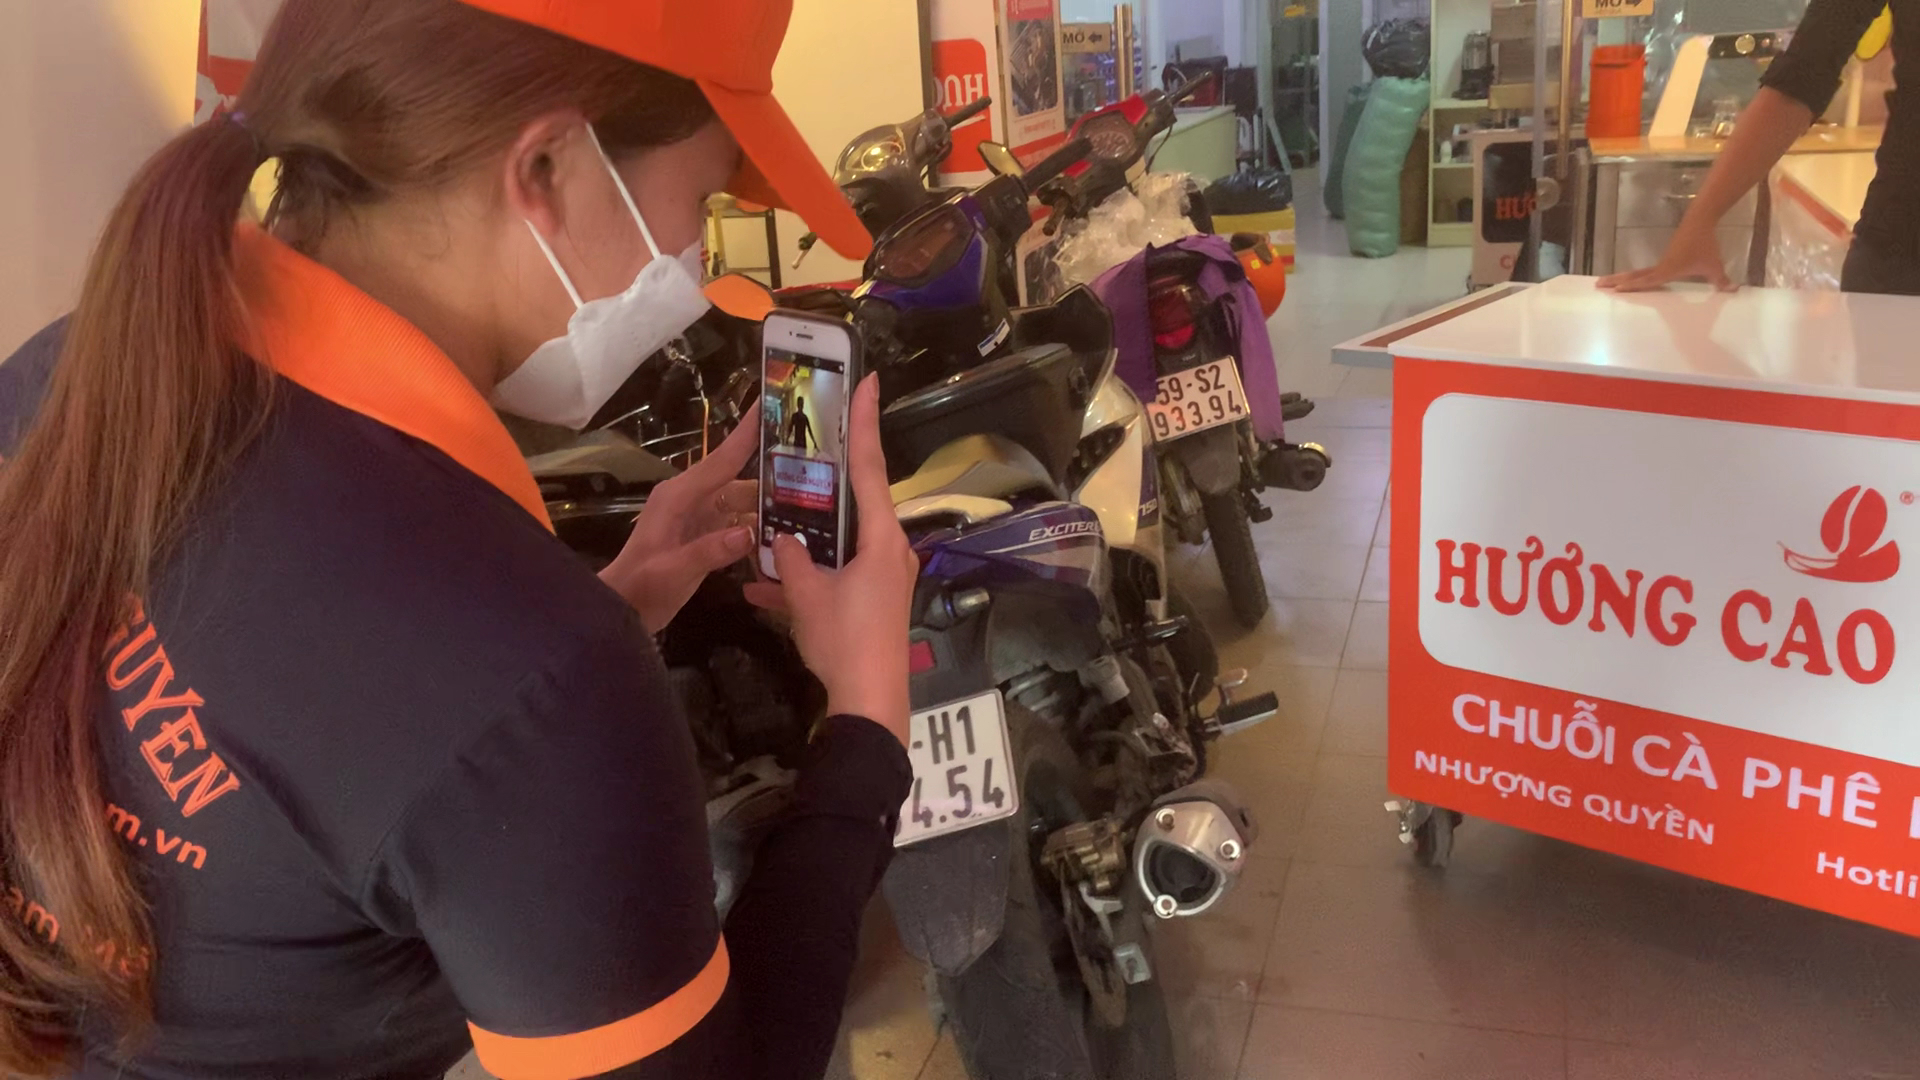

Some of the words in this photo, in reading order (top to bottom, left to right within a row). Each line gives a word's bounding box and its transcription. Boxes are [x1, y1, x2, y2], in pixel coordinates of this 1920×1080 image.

[1154, 389, 1242, 437] 933.94
[1157, 364, 1226, 406] 59-S2
[1434, 535, 1697, 647] HƯƠNG
[1720, 588, 1897, 685] CAO
[894, 758, 1005, 837] 4.54
[1413, 750, 1573, 808] NHƯỢNG
[1582, 793, 1715, 846] QUYỀN
[1452, 693, 1616, 765] CHUỖI
[1631, 731, 1719, 790] CÀ
[1742, 756, 1881, 829] PHÊ
[1815, 851, 1919, 899] Hotli
